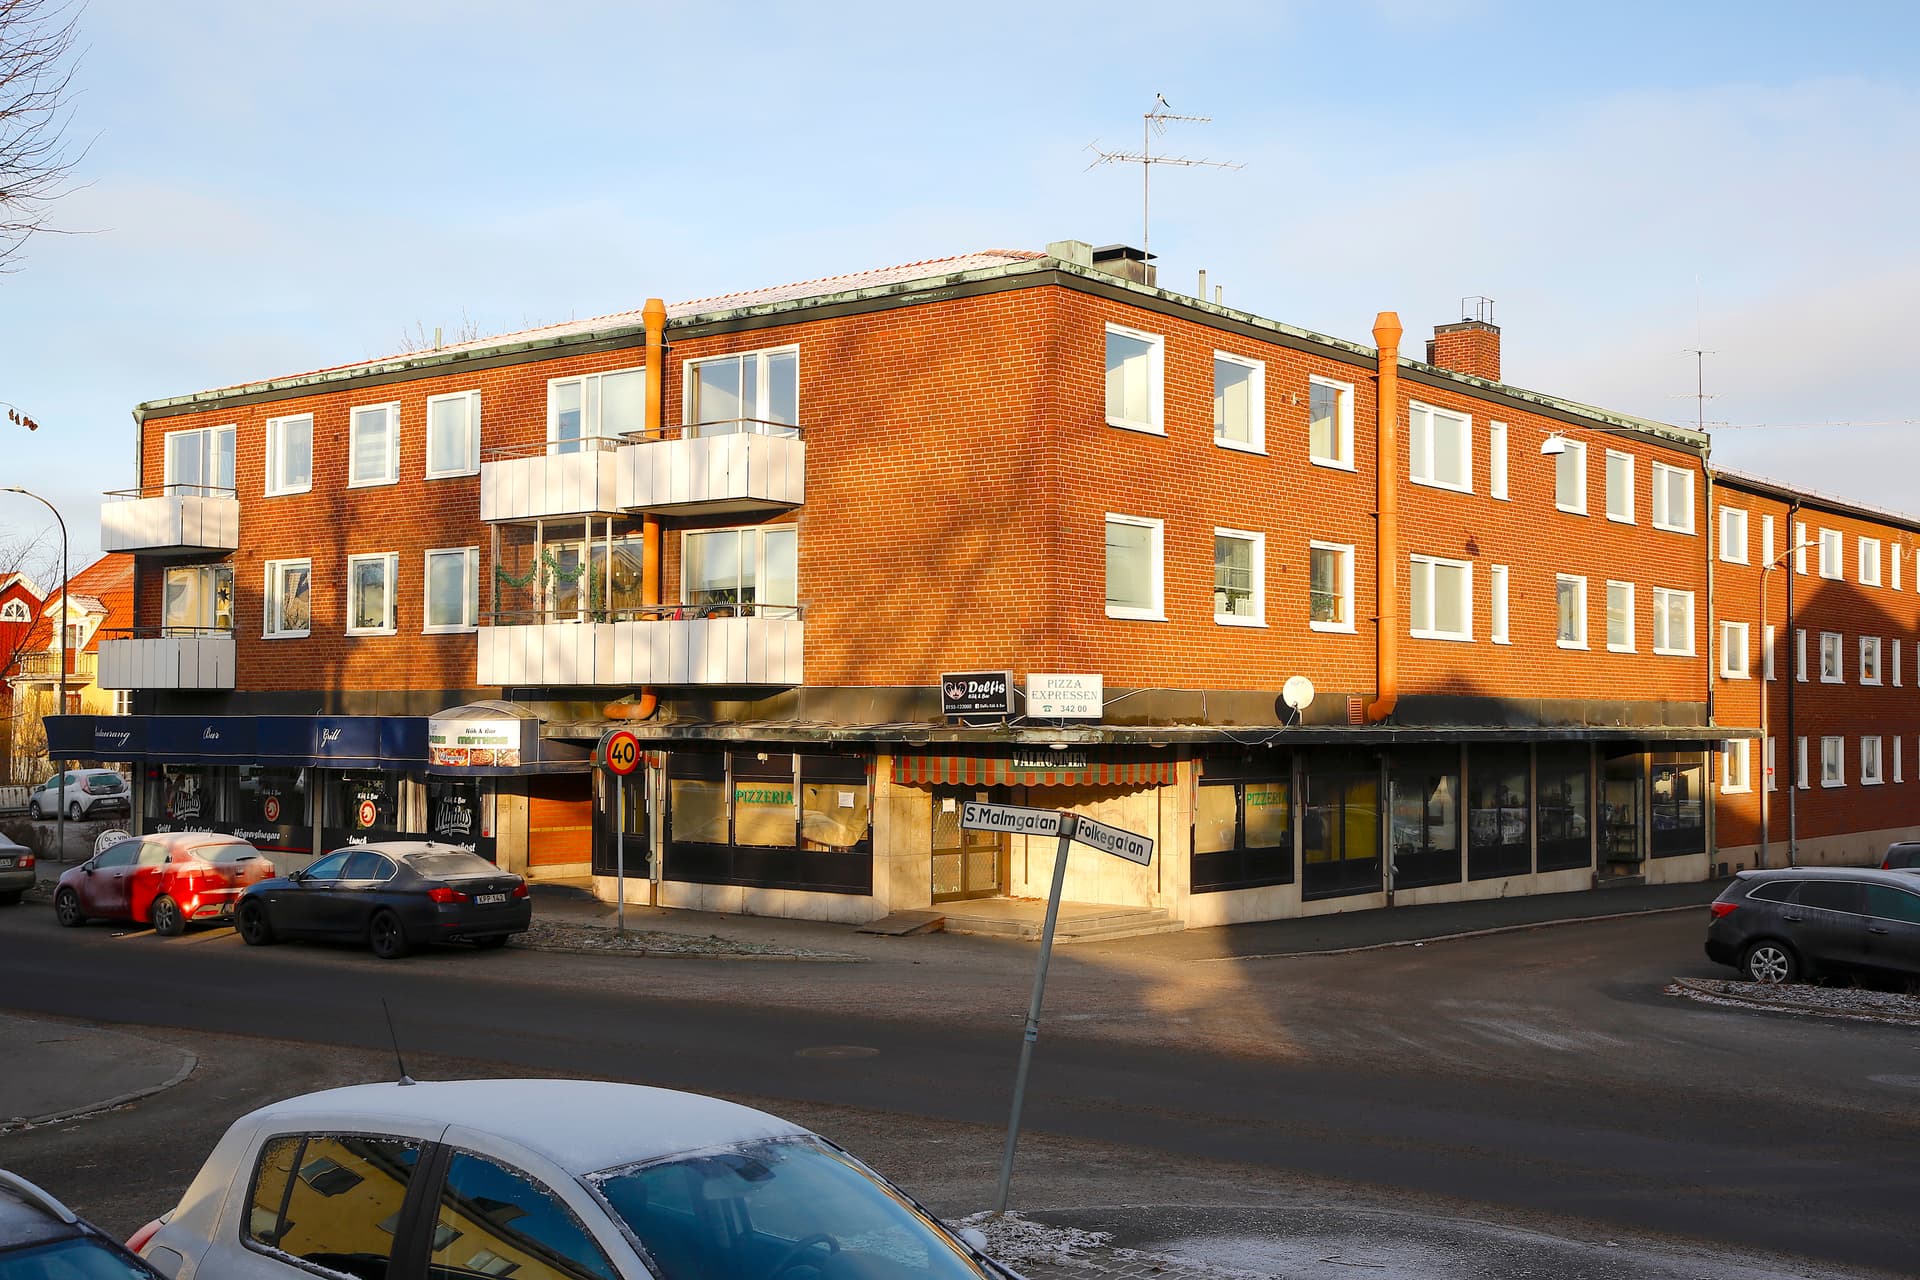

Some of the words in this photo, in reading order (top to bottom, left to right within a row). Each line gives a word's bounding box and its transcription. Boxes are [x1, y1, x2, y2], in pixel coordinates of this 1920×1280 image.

[968, 681, 1005, 695] Delfis
[1047, 679, 1082, 689] PIZZA
[1031, 691, 1098, 700] EXPRESSEN
[1060, 705, 1076, 713] 342
[1077, 705, 1087, 713] 00
[203, 726, 220, 739] Bar
[321, 728, 342, 748] Grill
[611, 742, 635, 763] 40
[735, 789, 794, 804] PIZZERIA
[1078, 820, 1144, 857] Folkegatan
